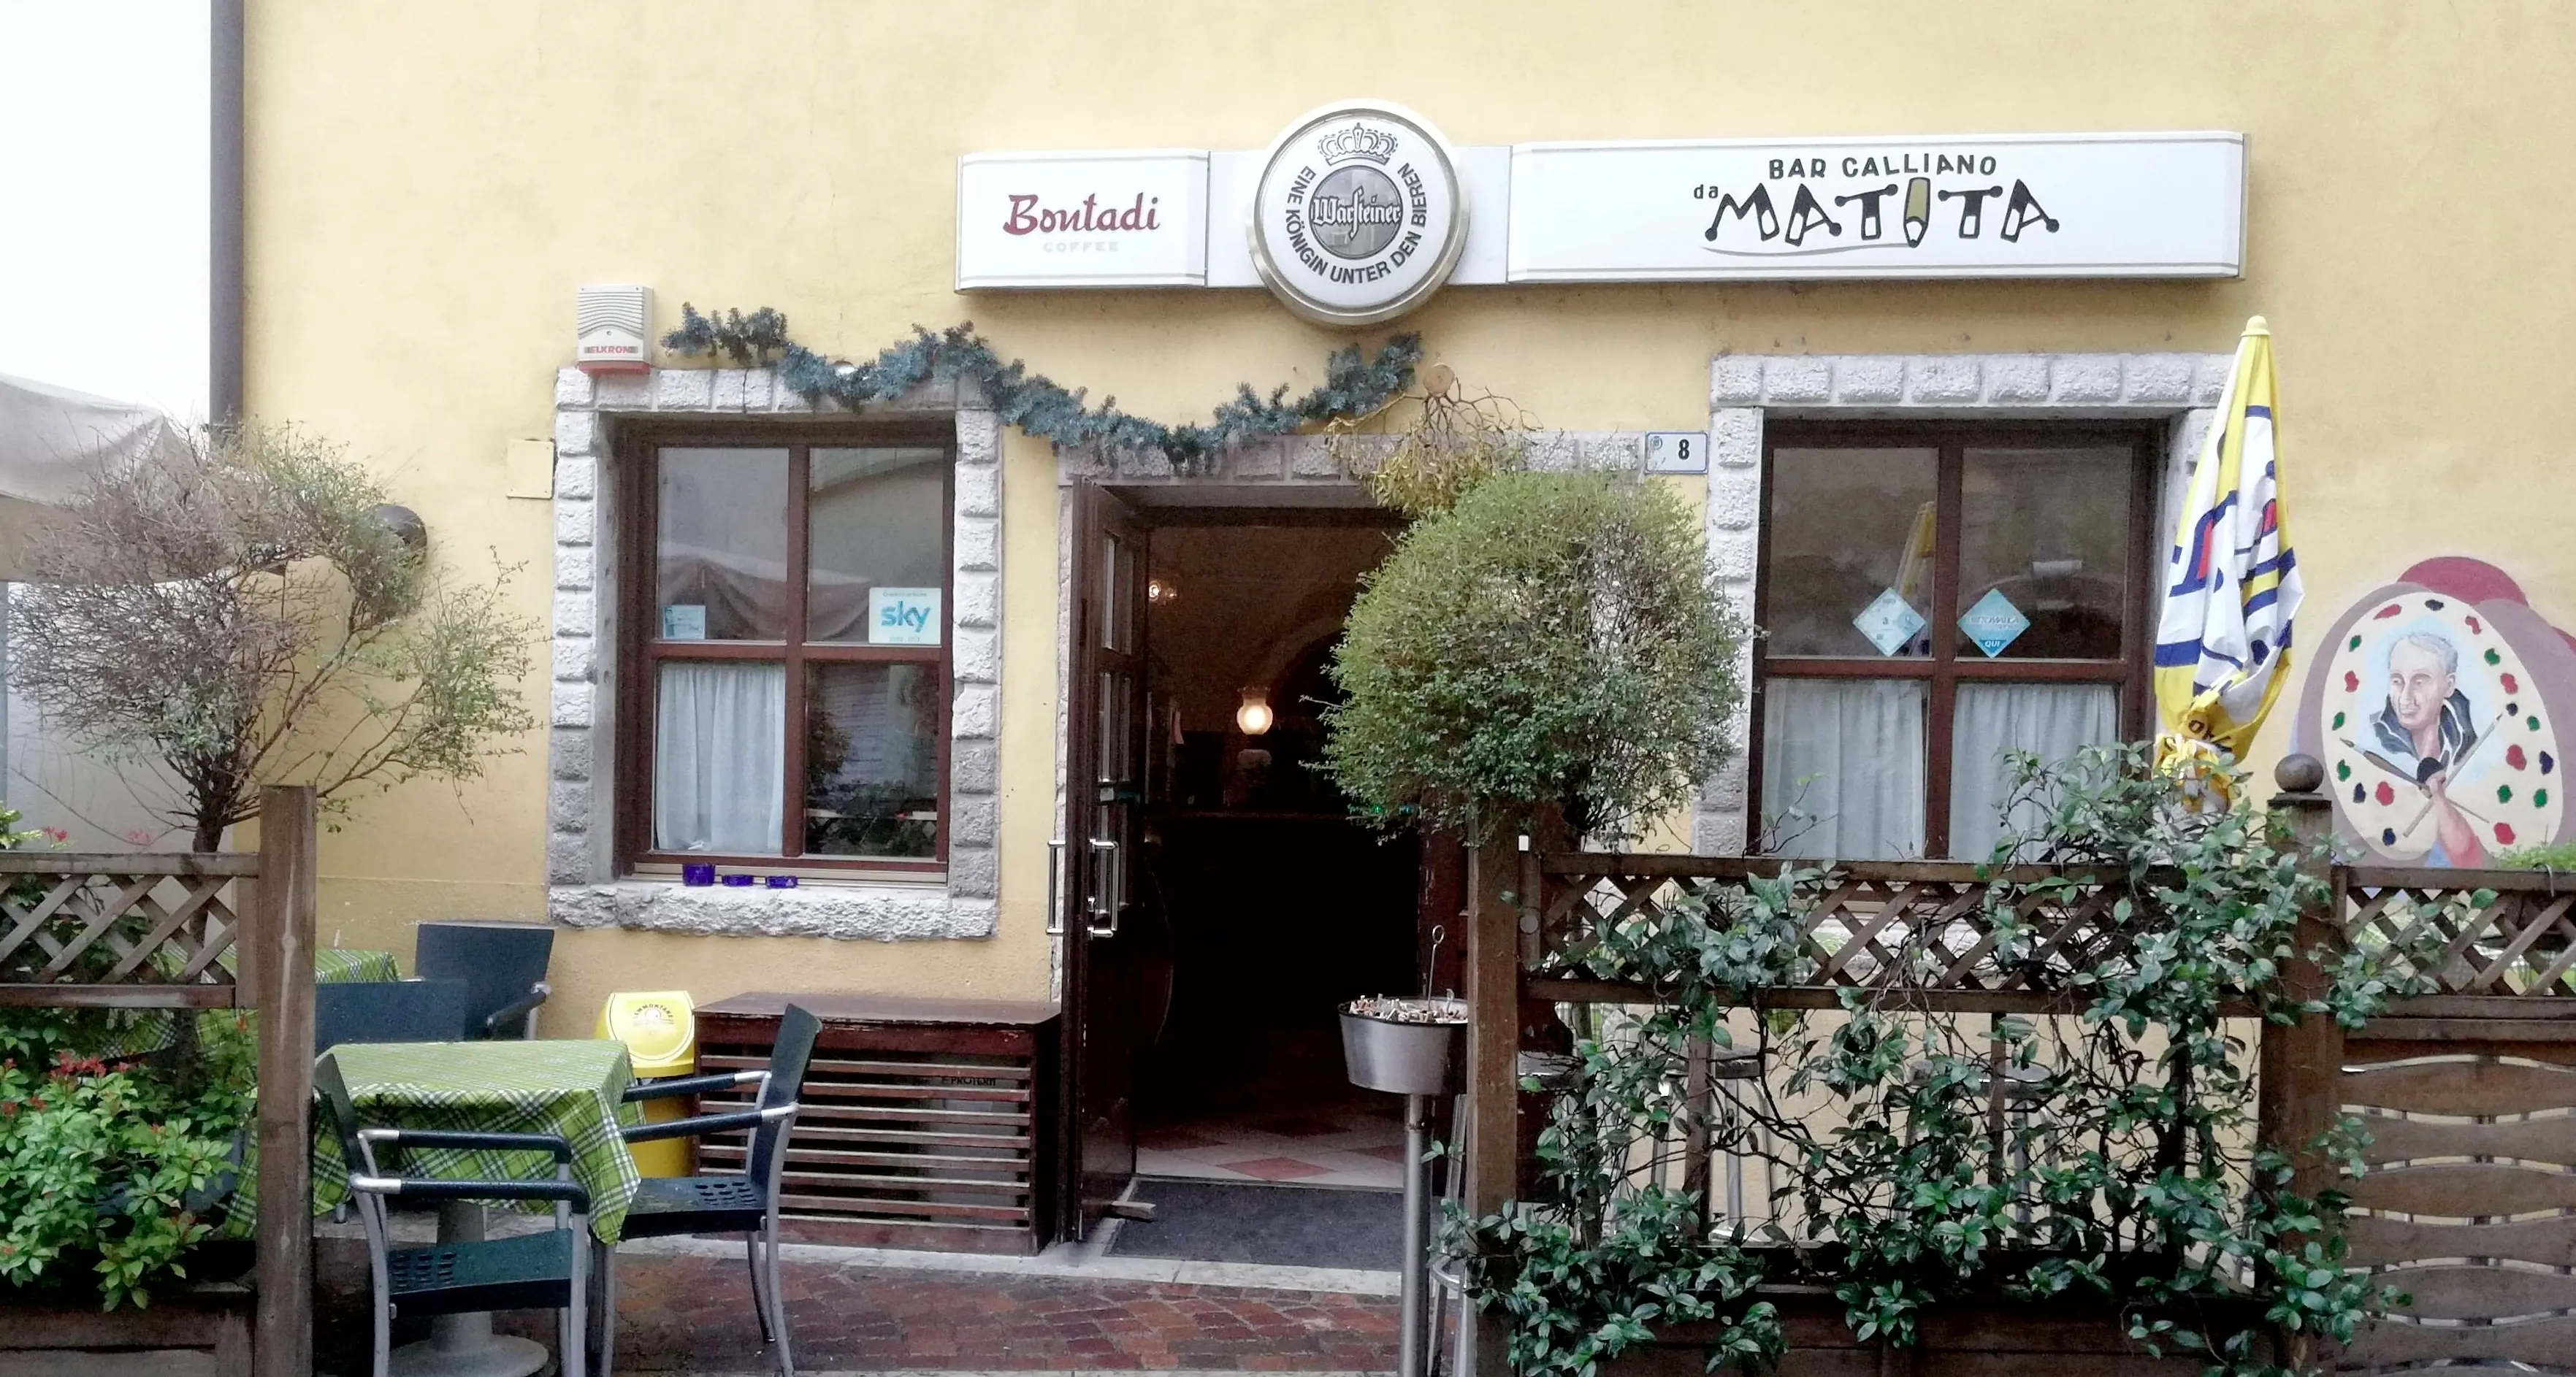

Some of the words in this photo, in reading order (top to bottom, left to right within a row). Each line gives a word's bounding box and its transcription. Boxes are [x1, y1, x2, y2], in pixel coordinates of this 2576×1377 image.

[1769, 158, 1826, 180] BAR
[1842, 153, 1997, 177] CALLIANO
[1287, 165, 1317, 205] EINE
[1397, 162, 1427, 229] BIEREN
[1693, 184, 1719, 199] da
[1003, 192, 1160, 235] Bontadi
[1313, 185, 1402, 242] Warsteiner
[1705, 177, 2060, 248] MATITA
[1043, 242, 1118, 253] COFFEE
[1285, 209, 1329, 277] KÖNIGIN
[1390, 231, 1422, 268] DEN
[1329, 261, 1391, 284] UNTER
[589, 345, 633, 354] ELKRON
[1678, 439, 1689, 460] 8
[881, 600, 930, 633] sky
[1984, 640, 2000, 648] QUI
